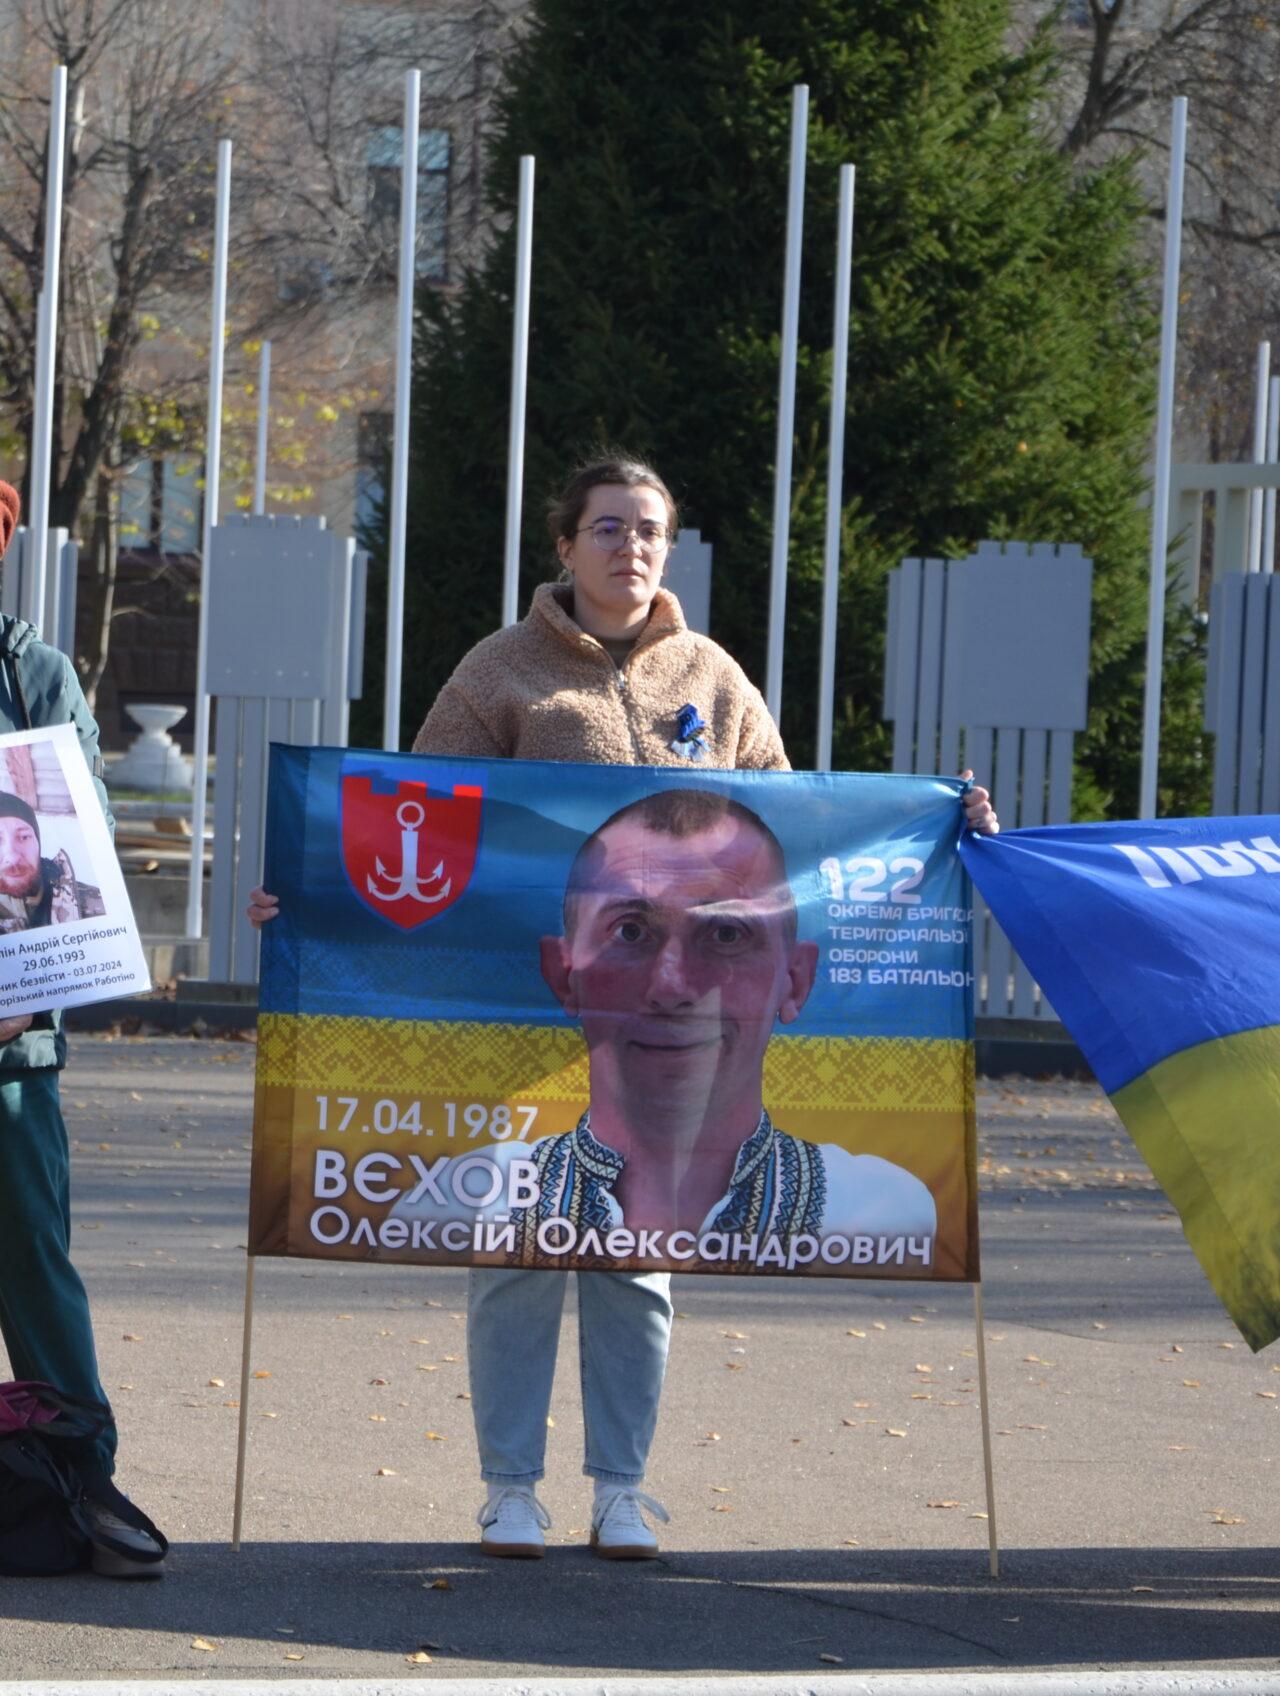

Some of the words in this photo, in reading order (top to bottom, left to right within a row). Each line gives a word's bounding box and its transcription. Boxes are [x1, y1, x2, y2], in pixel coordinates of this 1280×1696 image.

[819, 856, 925, 905] 122
[827, 903, 902, 921] ОКРЕМА
[18, 937, 60, 956] Андрій
[61, 926, 128, 946] Сергійович
[23, 950, 86, 972] 29.06.1993
[828, 948, 918, 964] ОБОРОНИ
[20, 972, 66, 989] безвісти
[73, 960, 122, 977] 03.07.2024
[46, 982, 94, 999] напрямок
[95, 972, 136, 988] Работіно
[829, 968, 861, 984] 183
[315, 1095, 539, 1141] 17.04.1987
[313, 1148, 542, 1209] ВЄХОВ
[308, 1206, 516, 1254] Олексій
[537, 1216, 932, 1271] Олександрович
